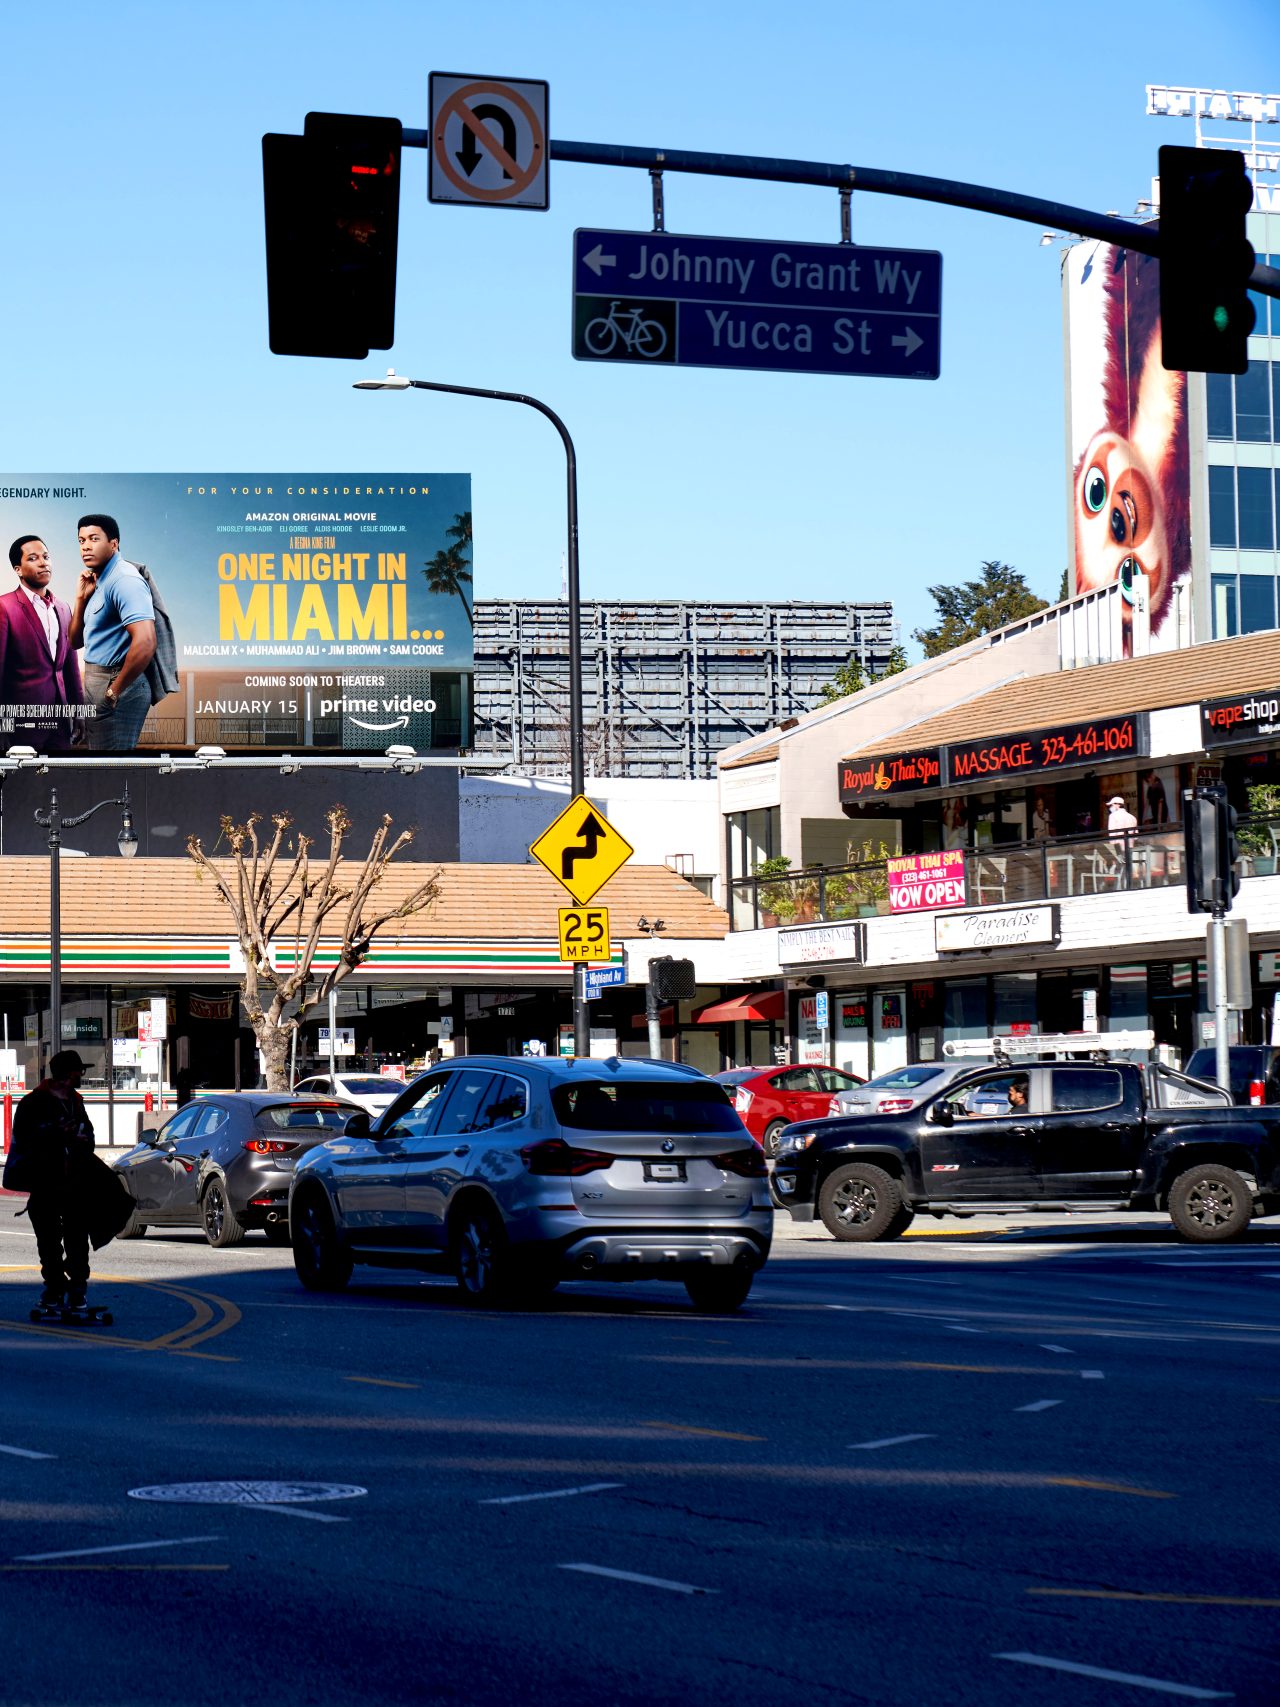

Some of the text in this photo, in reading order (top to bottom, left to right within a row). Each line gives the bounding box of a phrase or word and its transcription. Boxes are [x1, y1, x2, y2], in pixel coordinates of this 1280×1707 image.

[629, 246, 922, 304] Johnny Grant Wy
[705, 310, 872, 355] Yucca St
[52, 488, 87, 498] NIGHT.
[246, 512, 376, 521] AMAZON ORIGINAL MOVIE
[218, 553, 406, 581] ONE NIGHT IN
[219, 584, 445, 640] MIAMI...
[184, 645, 444, 656] MALCOLM X MUHAMMAD ALI JIM BROWN SAM COOKE
[245, 676, 385, 687] COMING SOON TO THEATERS
[196, 700, 298, 714] JANUARY 15
[320, 695, 436, 716] prime video
[955, 721, 1133, 776] MASSAGE 323-461-1061
[843, 758, 939, 793] Royal Thai Spa
[888, 852, 963, 873] ROYAL THAI SPA
[902, 868, 946, 884] (323) 461-1061
[925, 879, 965, 904] OPEN
[564, 913, 604, 942] 25
[964, 912, 1040, 931] Paradise
[804, 931, 817, 944] THE
[974, 931, 1029, 946] Cleaners
[567, 945, 602, 956] MPH
[589, 969, 622, 986] Highland Av
[842, 1006, 859, 1016] NAILS
[842, 1017, 865, 1026] WAXING
[882, 1015, 900, 1028] OPEN
